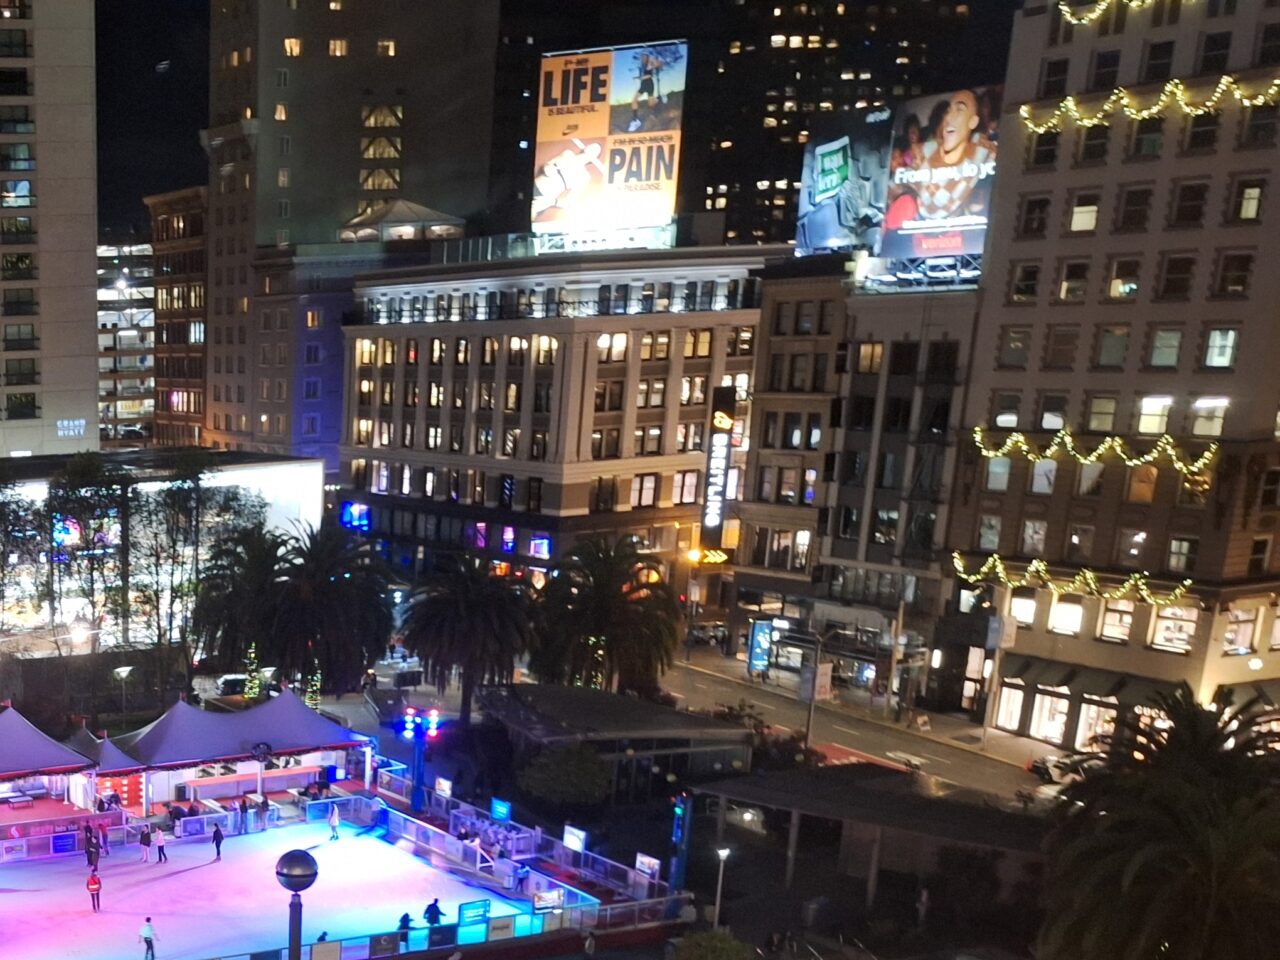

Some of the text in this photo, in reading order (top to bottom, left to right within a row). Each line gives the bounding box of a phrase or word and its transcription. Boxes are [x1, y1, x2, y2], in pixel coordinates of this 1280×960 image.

[542, 66, 609, 107] LIFE
[608, 144, 676, 184] PAIN
[894, 168, 931, 185] From
[962, 162, 979, 177] to
[979, 161, 997, 179] yo
[56, 419, 86, 428] GRAND
[57, 428, 85, 437] HYATT
[1133, 704, 1168, 720] GUCC
